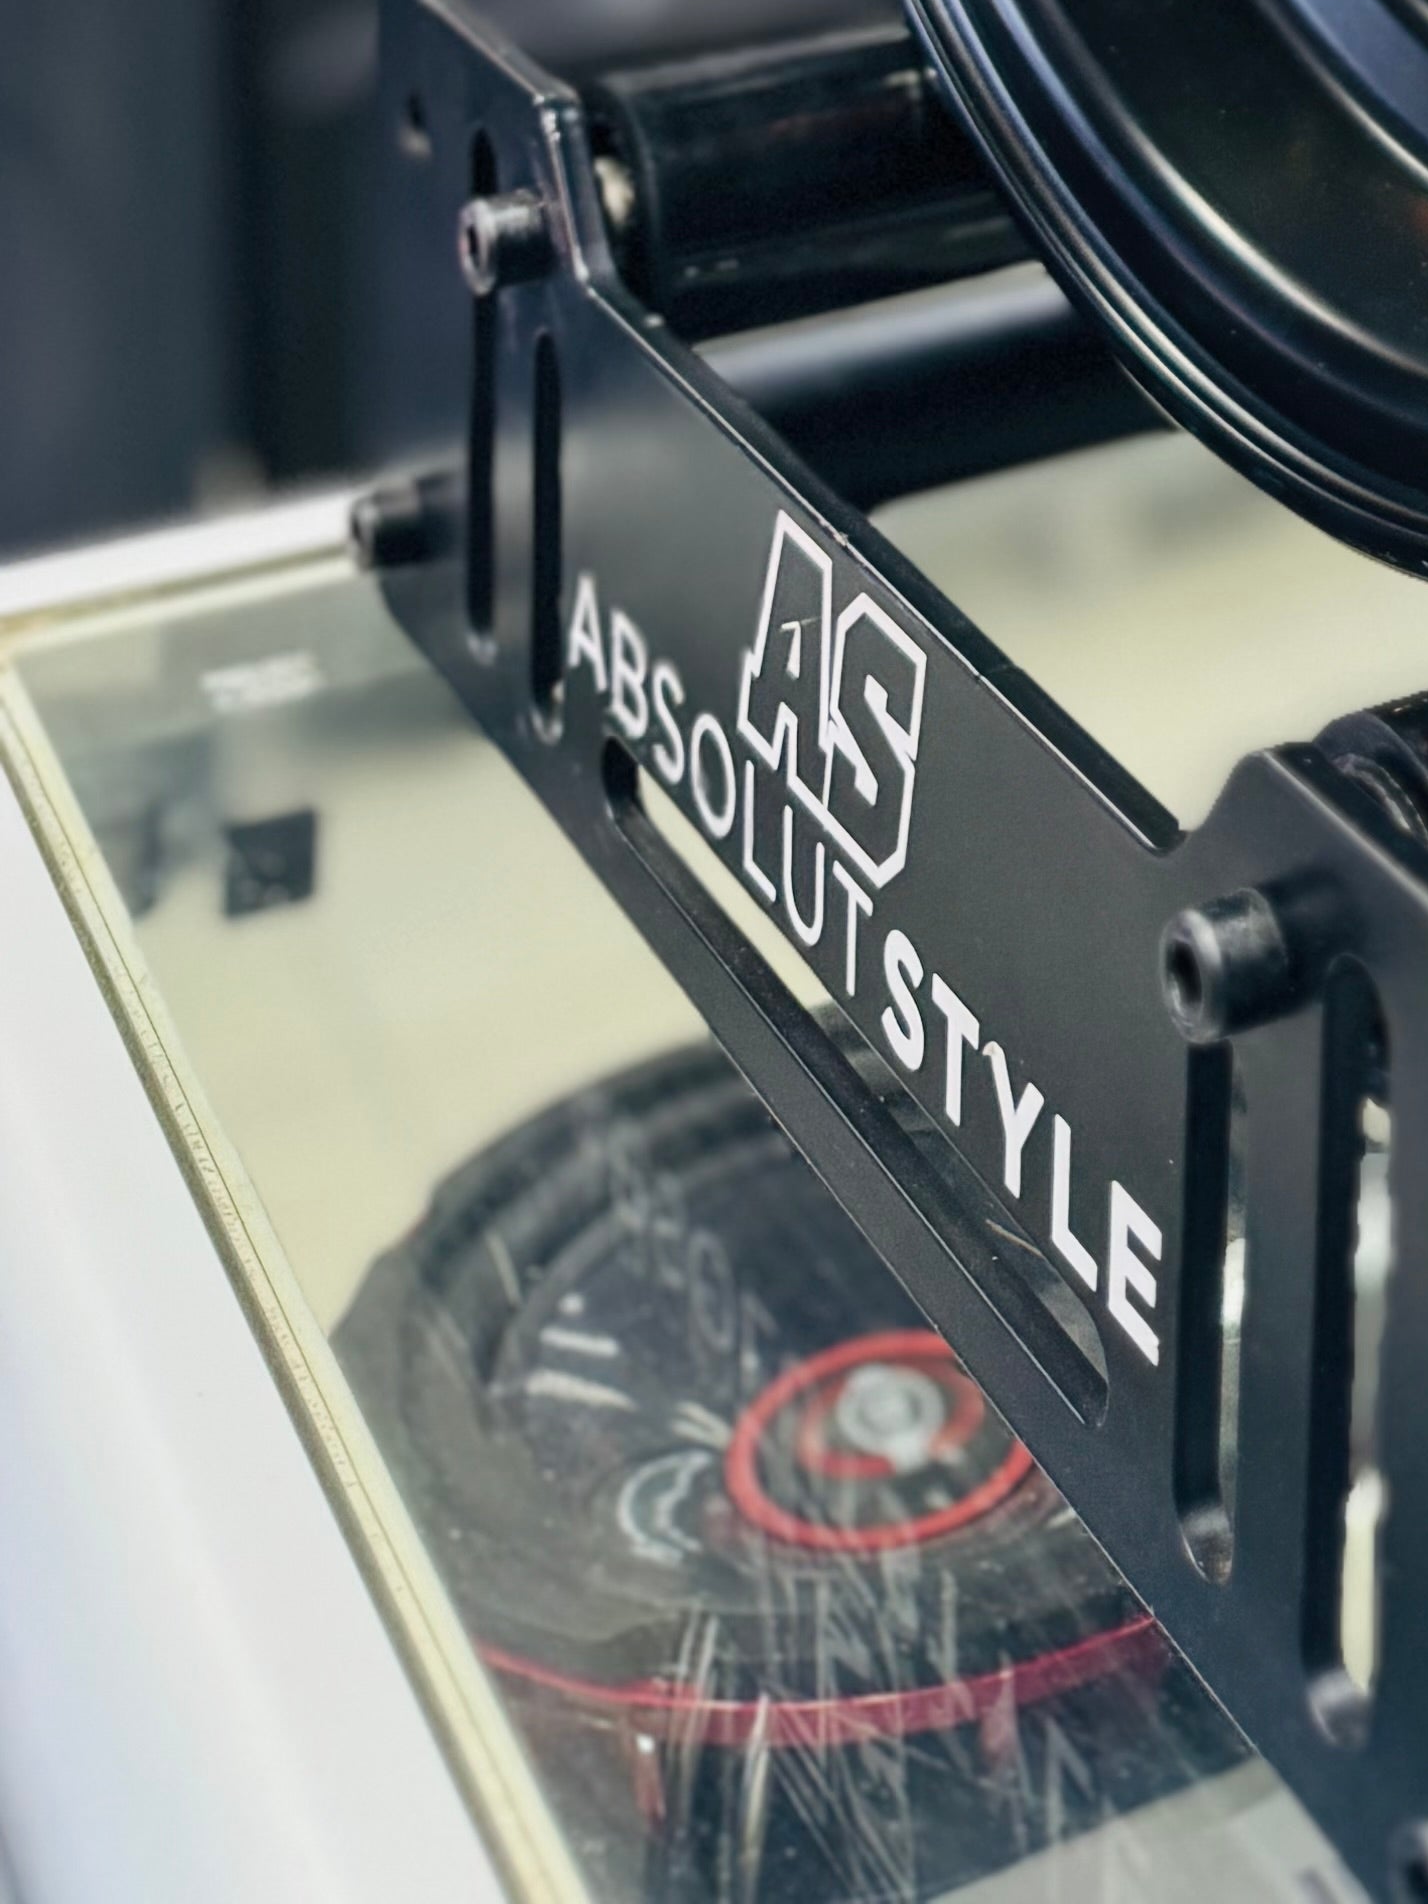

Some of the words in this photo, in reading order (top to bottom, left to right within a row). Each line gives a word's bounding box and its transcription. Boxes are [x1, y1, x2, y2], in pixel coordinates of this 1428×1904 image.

[569, 574, 873, 996] ABSOLUT
[881, 930, 1162, 1366] STYLE
[740, 510, 925, 889] AS
